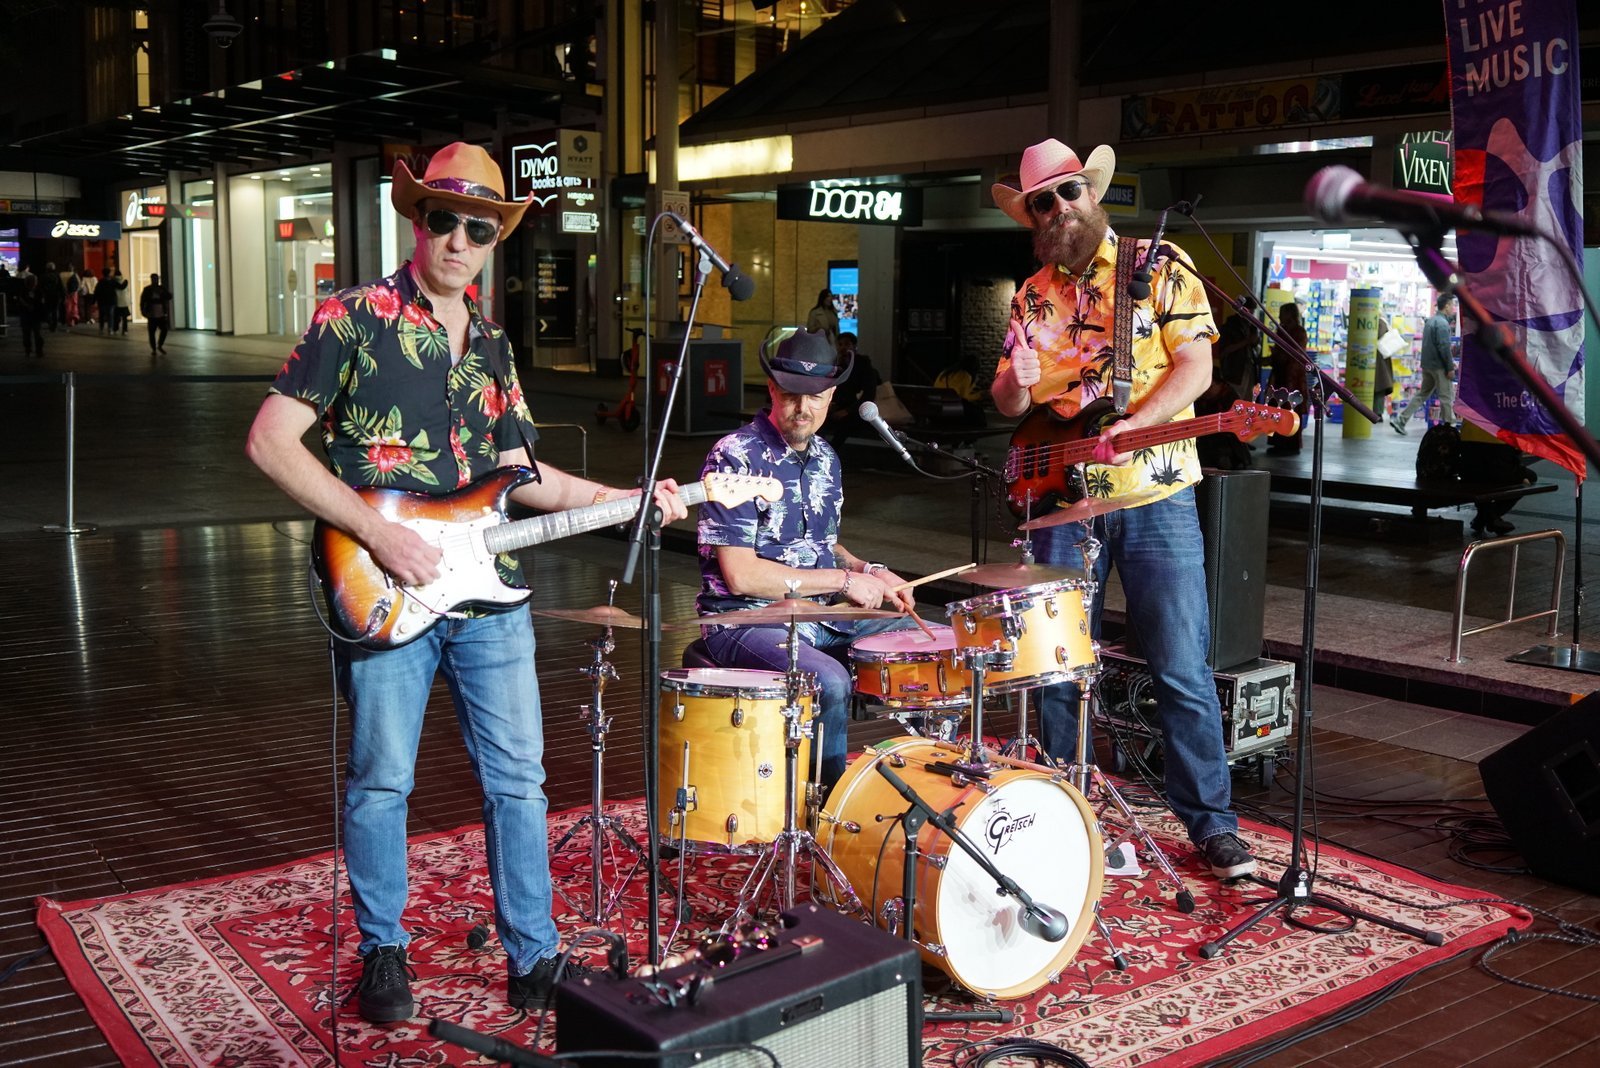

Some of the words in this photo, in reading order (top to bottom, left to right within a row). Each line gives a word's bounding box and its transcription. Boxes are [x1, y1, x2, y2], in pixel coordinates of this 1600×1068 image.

[1460, 0, 1524, 53] LIVE
[1465, 38, 1569, 97] MUSIC
[1151, 84, 1309, 134] TATTOO
[520, 155, 558, 178] DYMO
[567, 156, 593, 164] HYATT
[1400, 148, 1454, 196] VIXEN
[532, 176, 556, 190] books
[809, 187, 874, 219] DOOR
[873, 190, 903, 221] 84
[1494, 392, 1518, 409] The
[989, 812, 1037, 856] GRETSCH
